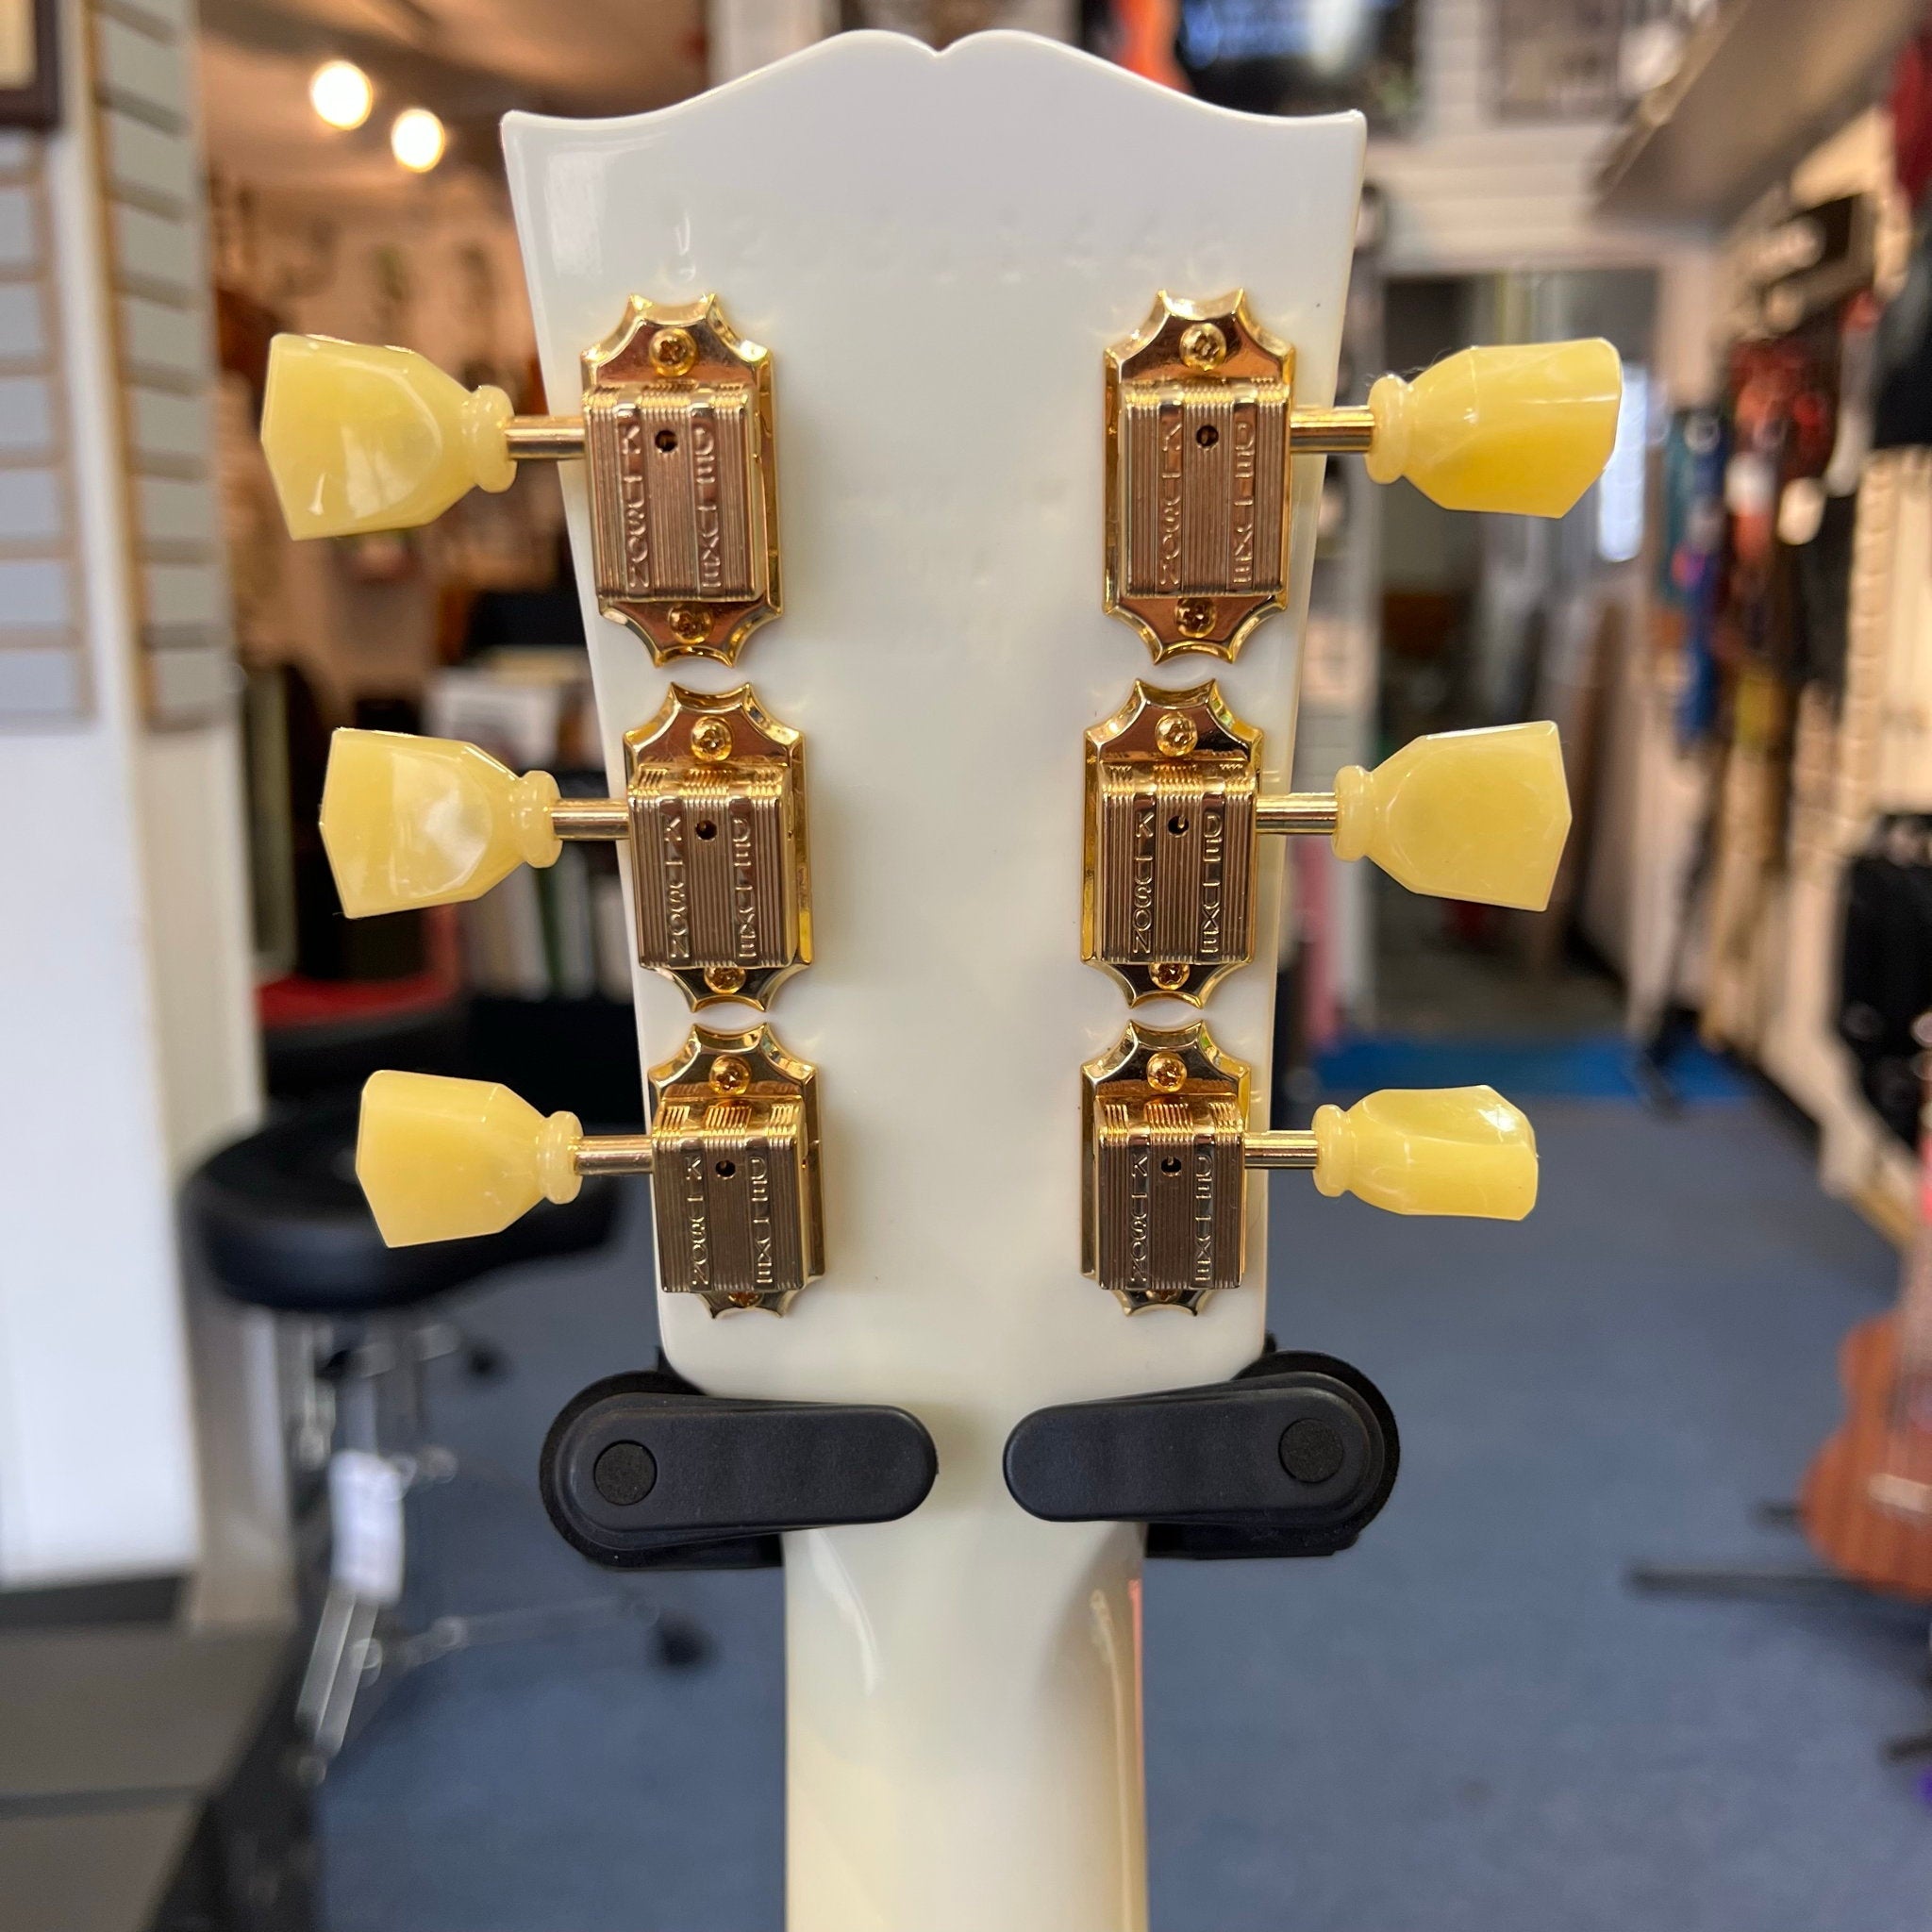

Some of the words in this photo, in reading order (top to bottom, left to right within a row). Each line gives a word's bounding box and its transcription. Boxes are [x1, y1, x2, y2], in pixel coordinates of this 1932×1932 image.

[621, 425, 650, 588] KLUSON
[694, 426, 723, 588] DELUXE
[1160, 423, 1183, 585] KLUSON
[1233, 422, 1256, 584] DELUXE
[663, 816, 690, 958] KLUSON
[732, 818, 758, 958] DELUXE
[1132, 811, 1156, 954] KLUSON
[1201, 811, 1223, 954] DELUXE
[685, 1155, 709, 1285] KLUSON
[750, 1157, 774, 1284] DELUXE
[1130, 1154, 1149, 1282] KLUSON
[1194, 1154, 1213, 1281] DELUXE
